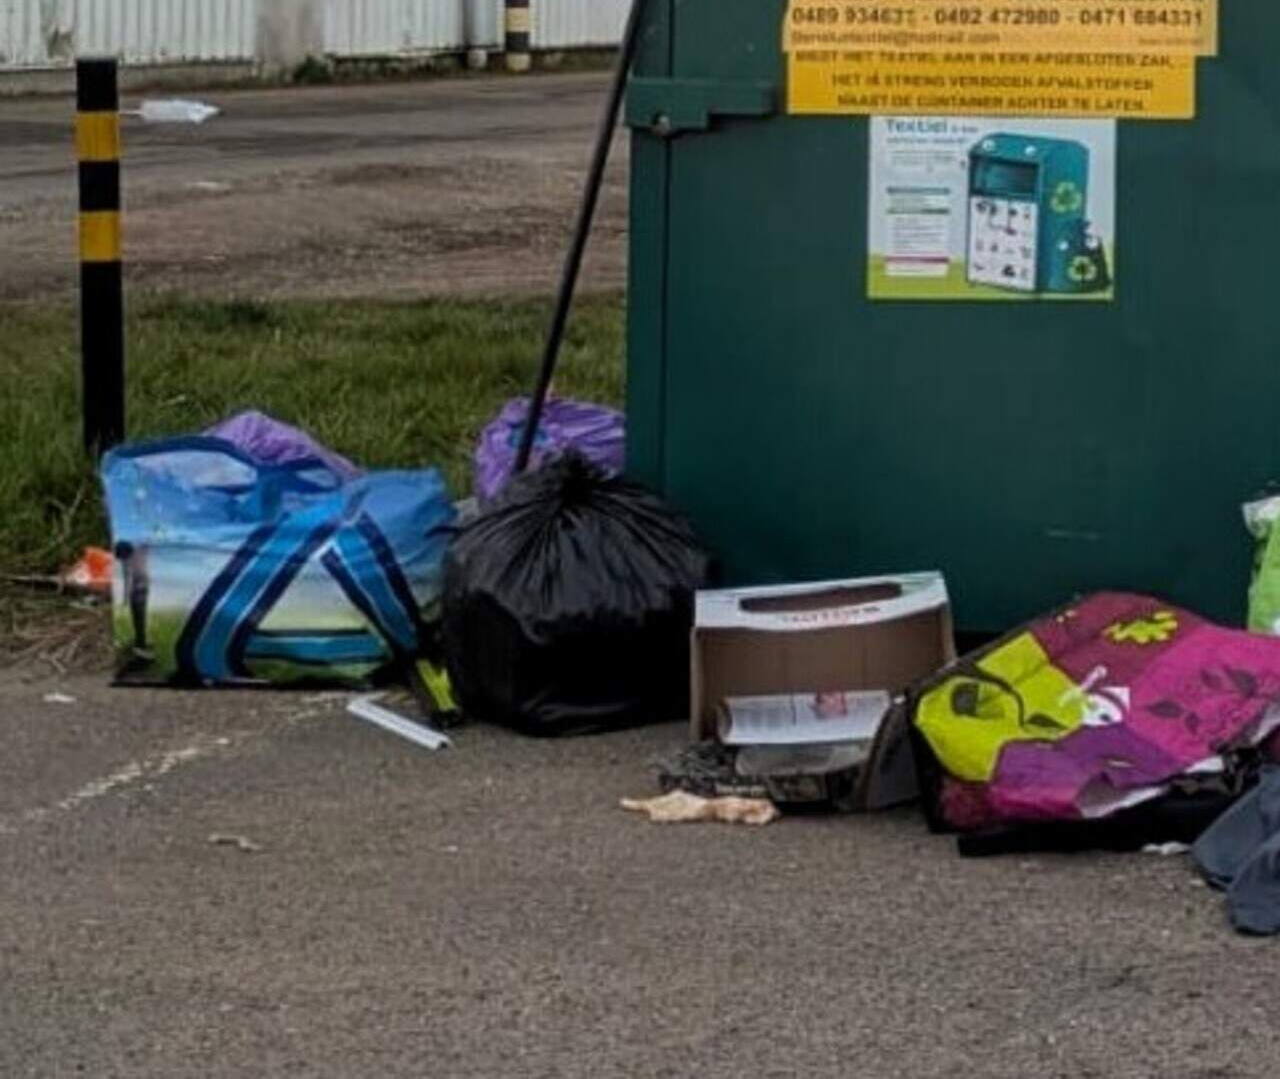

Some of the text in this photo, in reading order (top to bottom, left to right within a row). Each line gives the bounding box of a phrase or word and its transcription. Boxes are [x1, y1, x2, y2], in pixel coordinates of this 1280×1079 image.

[792, 6, 839, 23] 0489
[935, 8, 983, 25] 0492
[990, 9, 1061, 25] 472980
[1079, 9, 1125, 25] 0471
